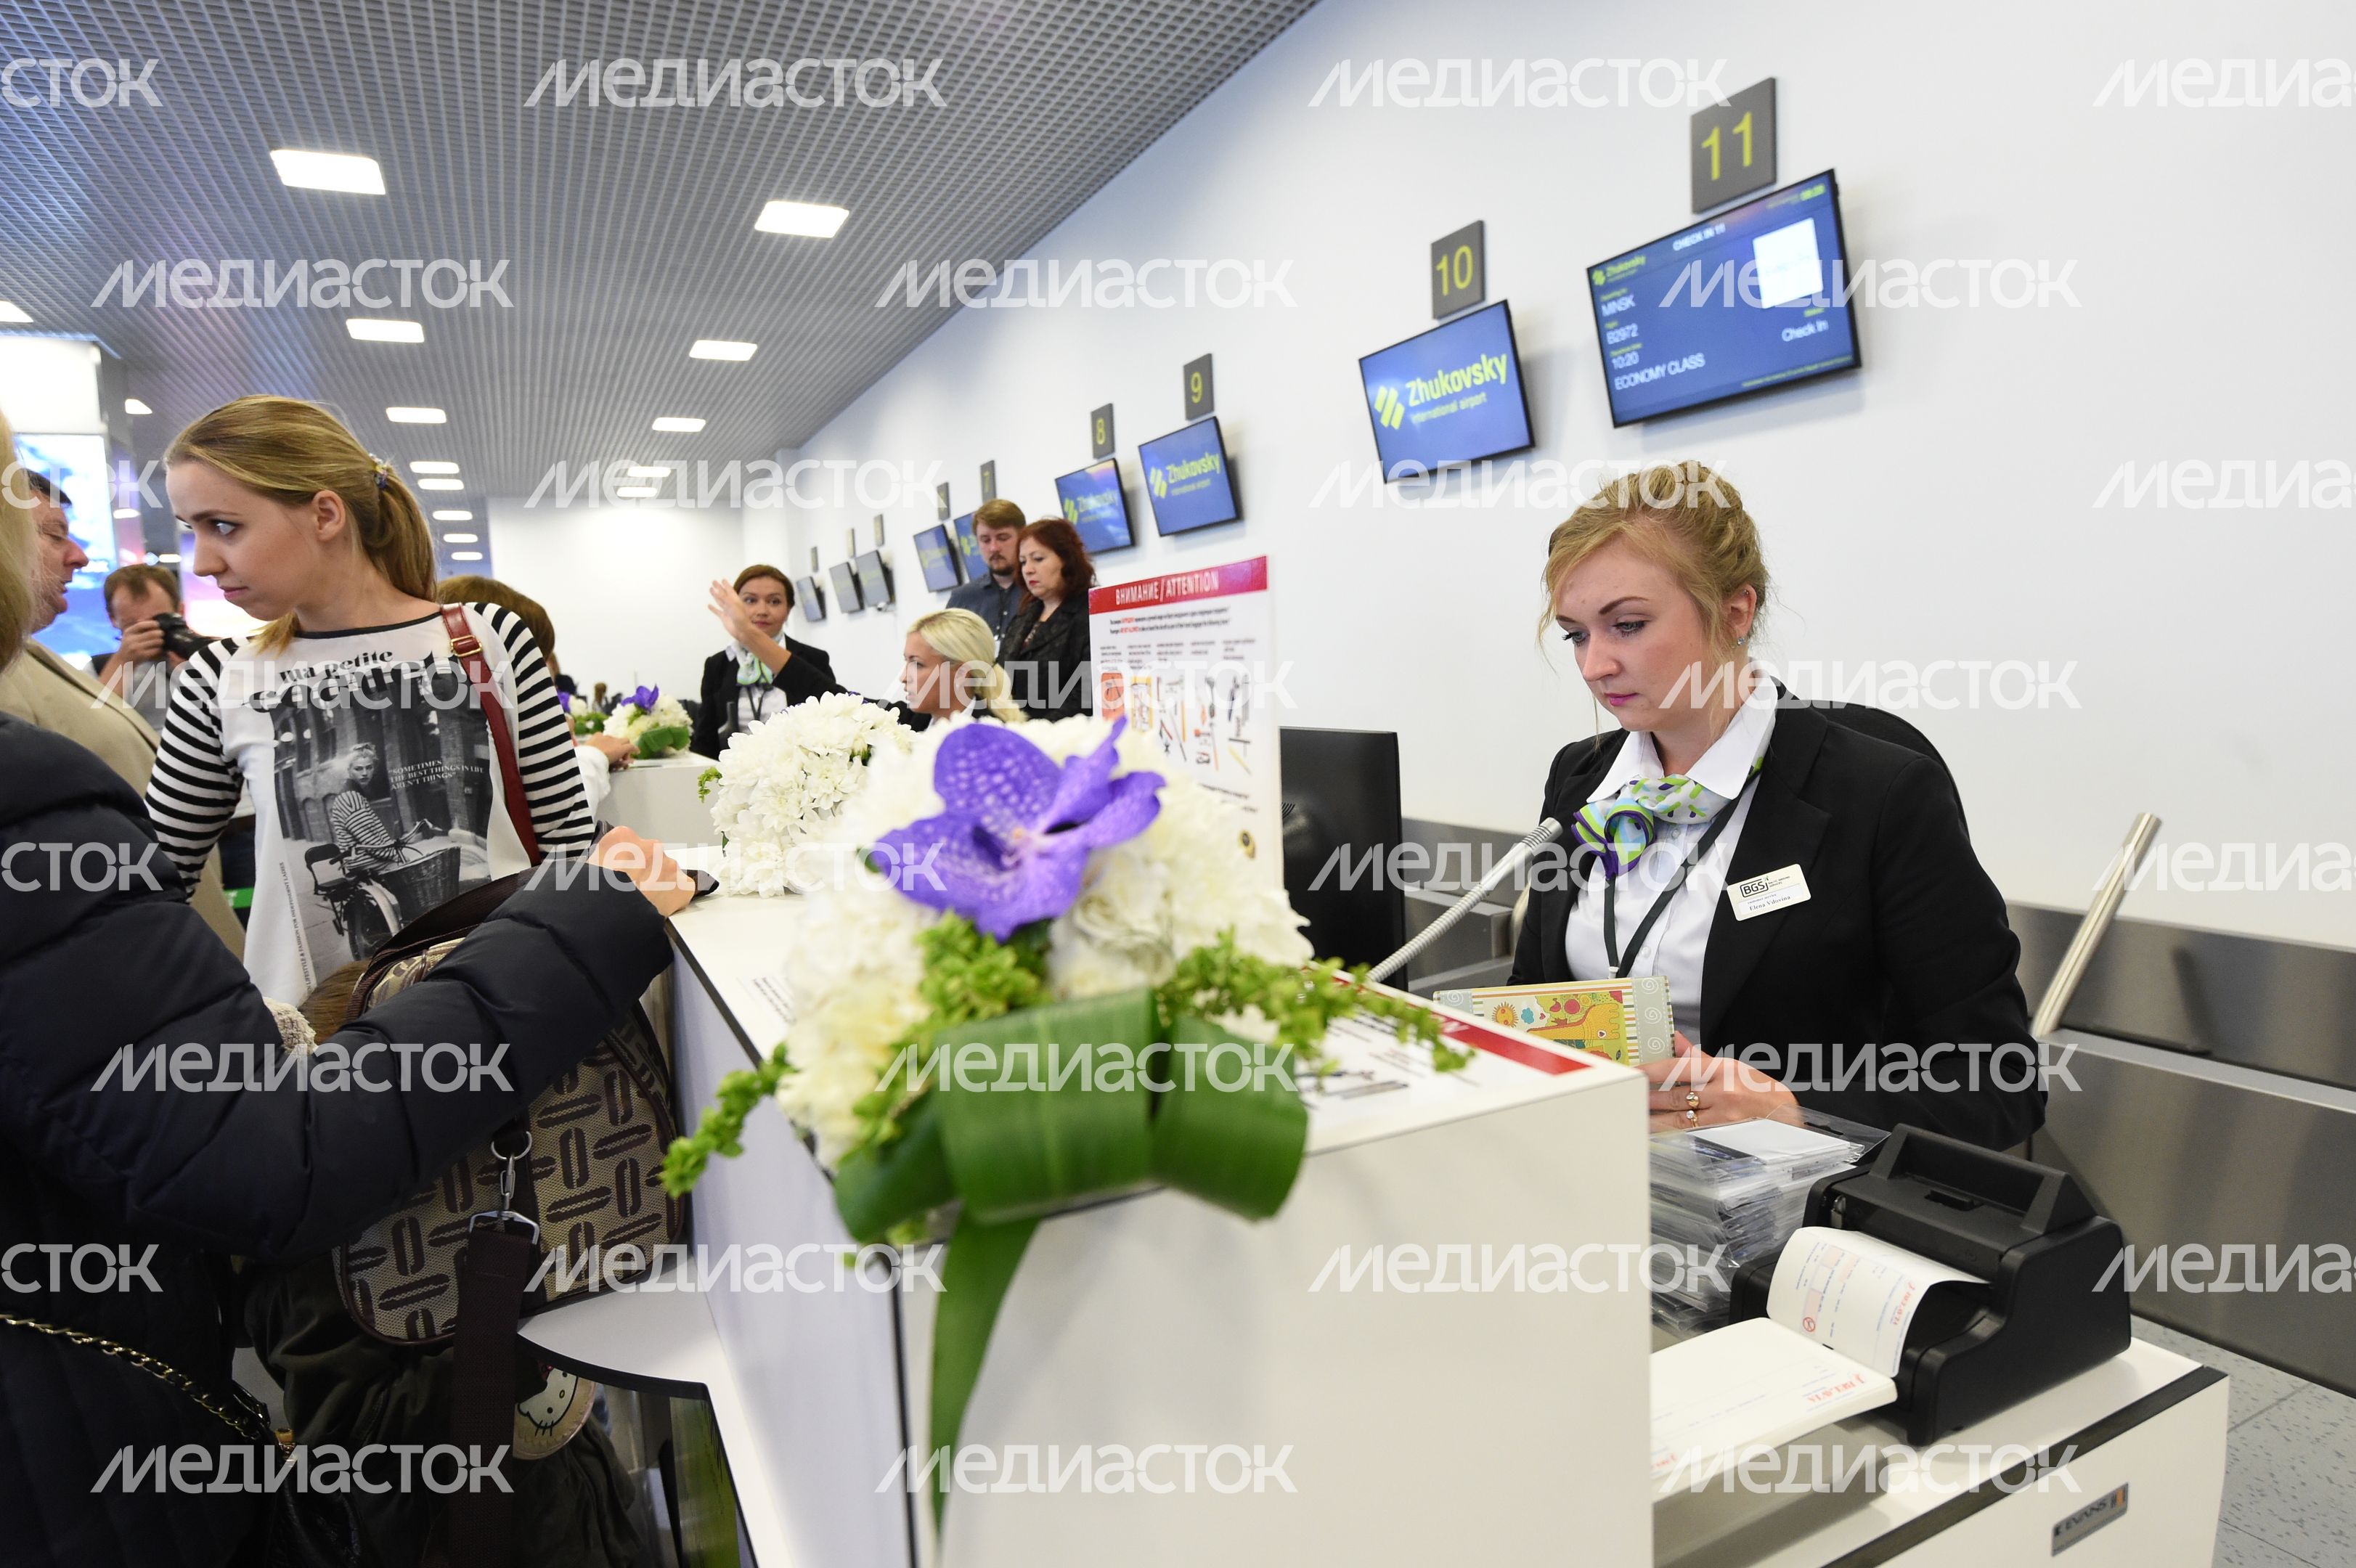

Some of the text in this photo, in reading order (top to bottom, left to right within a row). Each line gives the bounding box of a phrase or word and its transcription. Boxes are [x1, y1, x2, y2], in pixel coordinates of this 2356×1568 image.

[1701, 110, 1753, 181] 11
[1673, 232, 1703, 251] CHECK
[1436, 245, 1473, 295] 10
[1601, 294, 1636, 317] MINSK
[1782, 322, 1816, 342] Check
[1406, 354, 1507, 407] Zhukovsky
[1614, 352, 1705, 391] ECONOMY CLASS
[1191, 371, 1203, 404] 9
[1096, 417, 1106, 445] 8
[1166, 452, 1220, 484] Zhukovsky
[1115, 581, 1159, 605] ВНИМАНИЕ
[1166, 571, 1219, 597] ATTENTION
[324, 650, 393, 679] petite
[408, 769, 427, 779] BEST
[431, 765, 460, 774] THINGS
[1743, 881, 1765, 894] BGS
[1766, 896, 1790, 905] Vdovina
